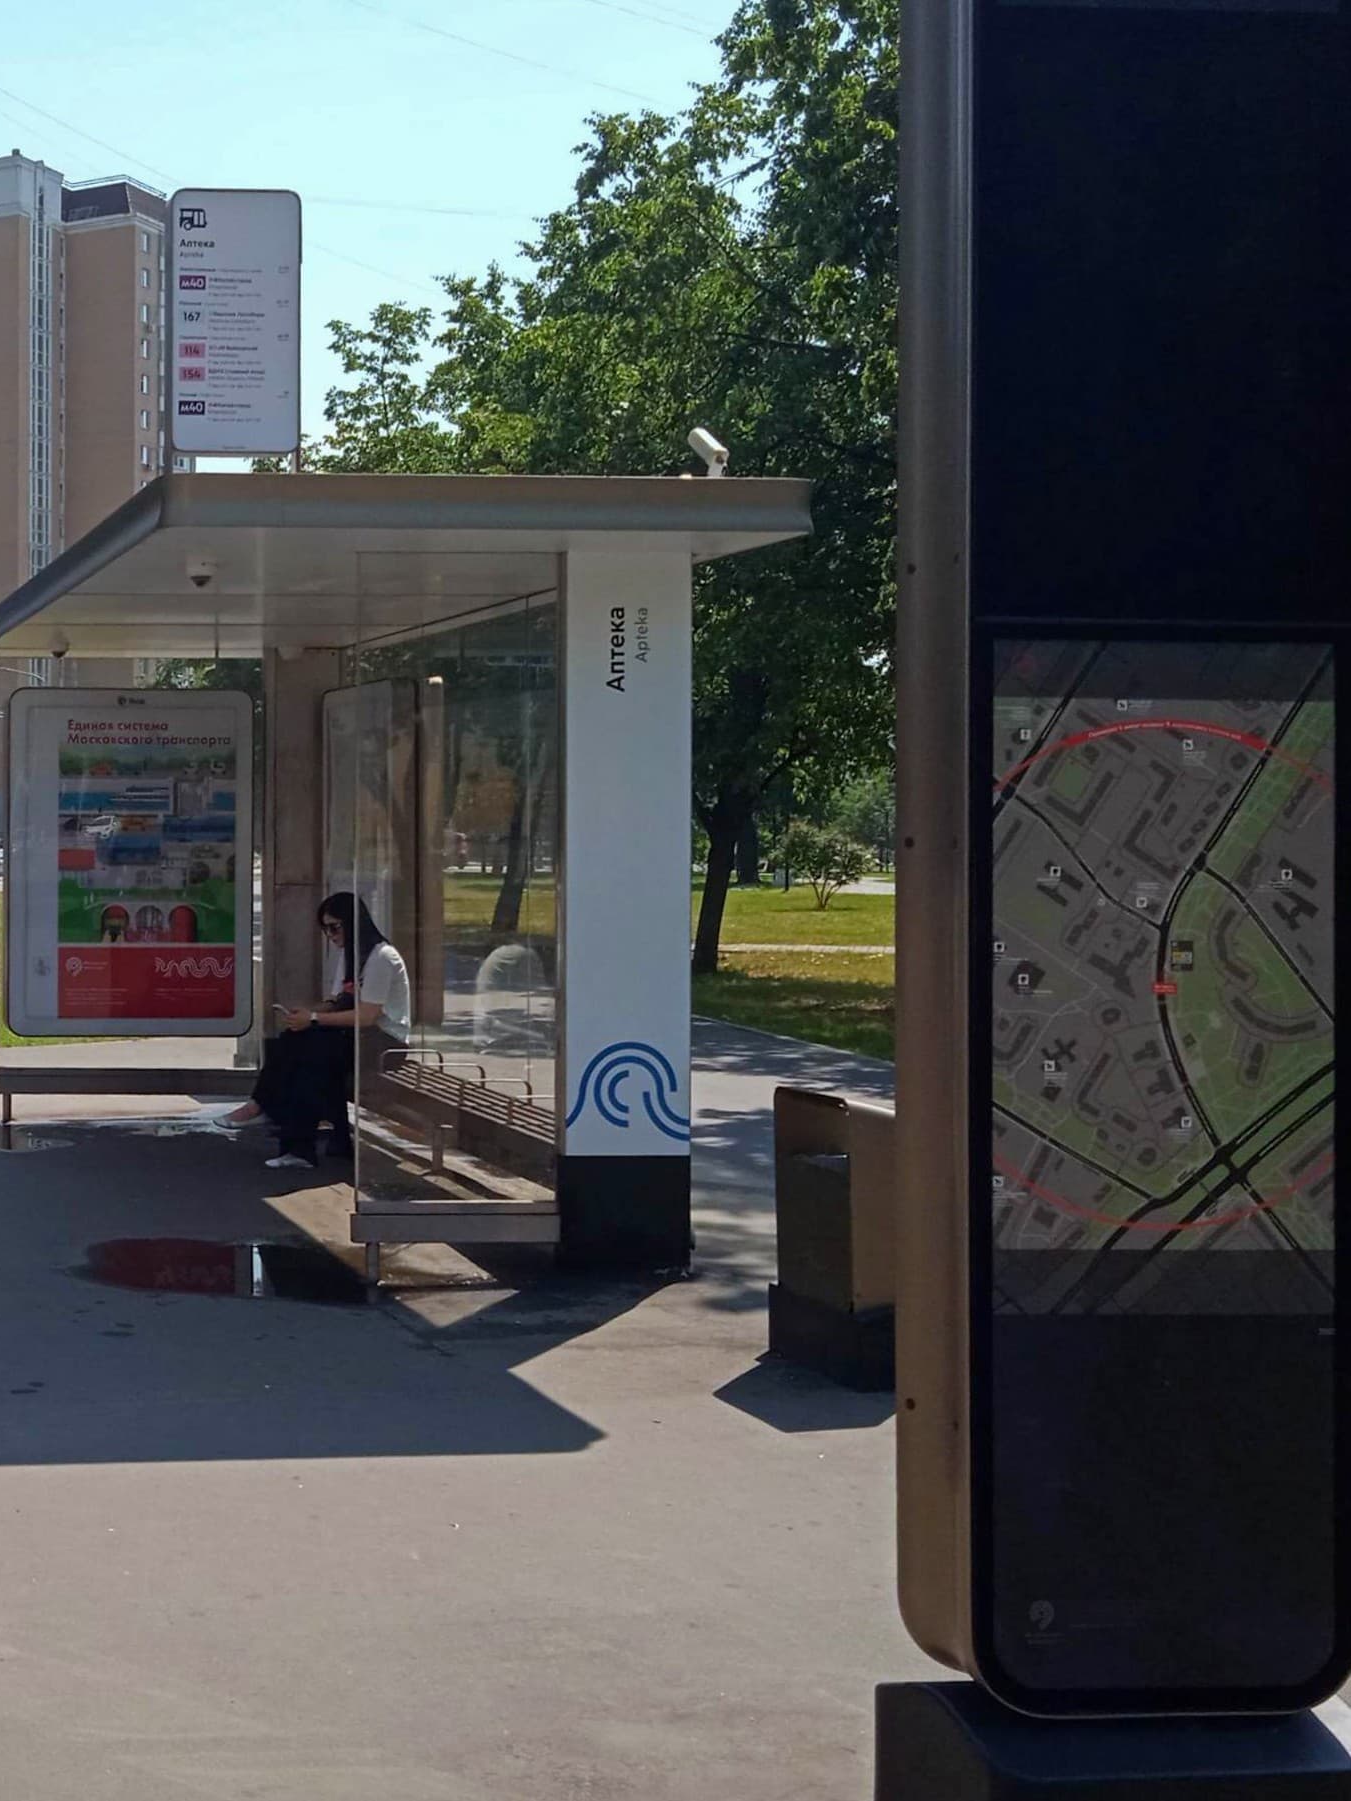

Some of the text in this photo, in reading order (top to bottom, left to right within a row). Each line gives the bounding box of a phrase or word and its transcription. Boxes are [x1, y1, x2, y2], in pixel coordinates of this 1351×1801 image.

[179, 239, 215, 248] Аптека
[183, 311, 201, 322] 167
[184, 345, 200, 356] 114
[183, 368, 201, 379] 154
[634, 607, 651, 663] Apteka
[606, 607, 625, 692] Аптека
[67, 719, 169, 732] Единая система
[67, 734, 231, 747] Московского транспорта
